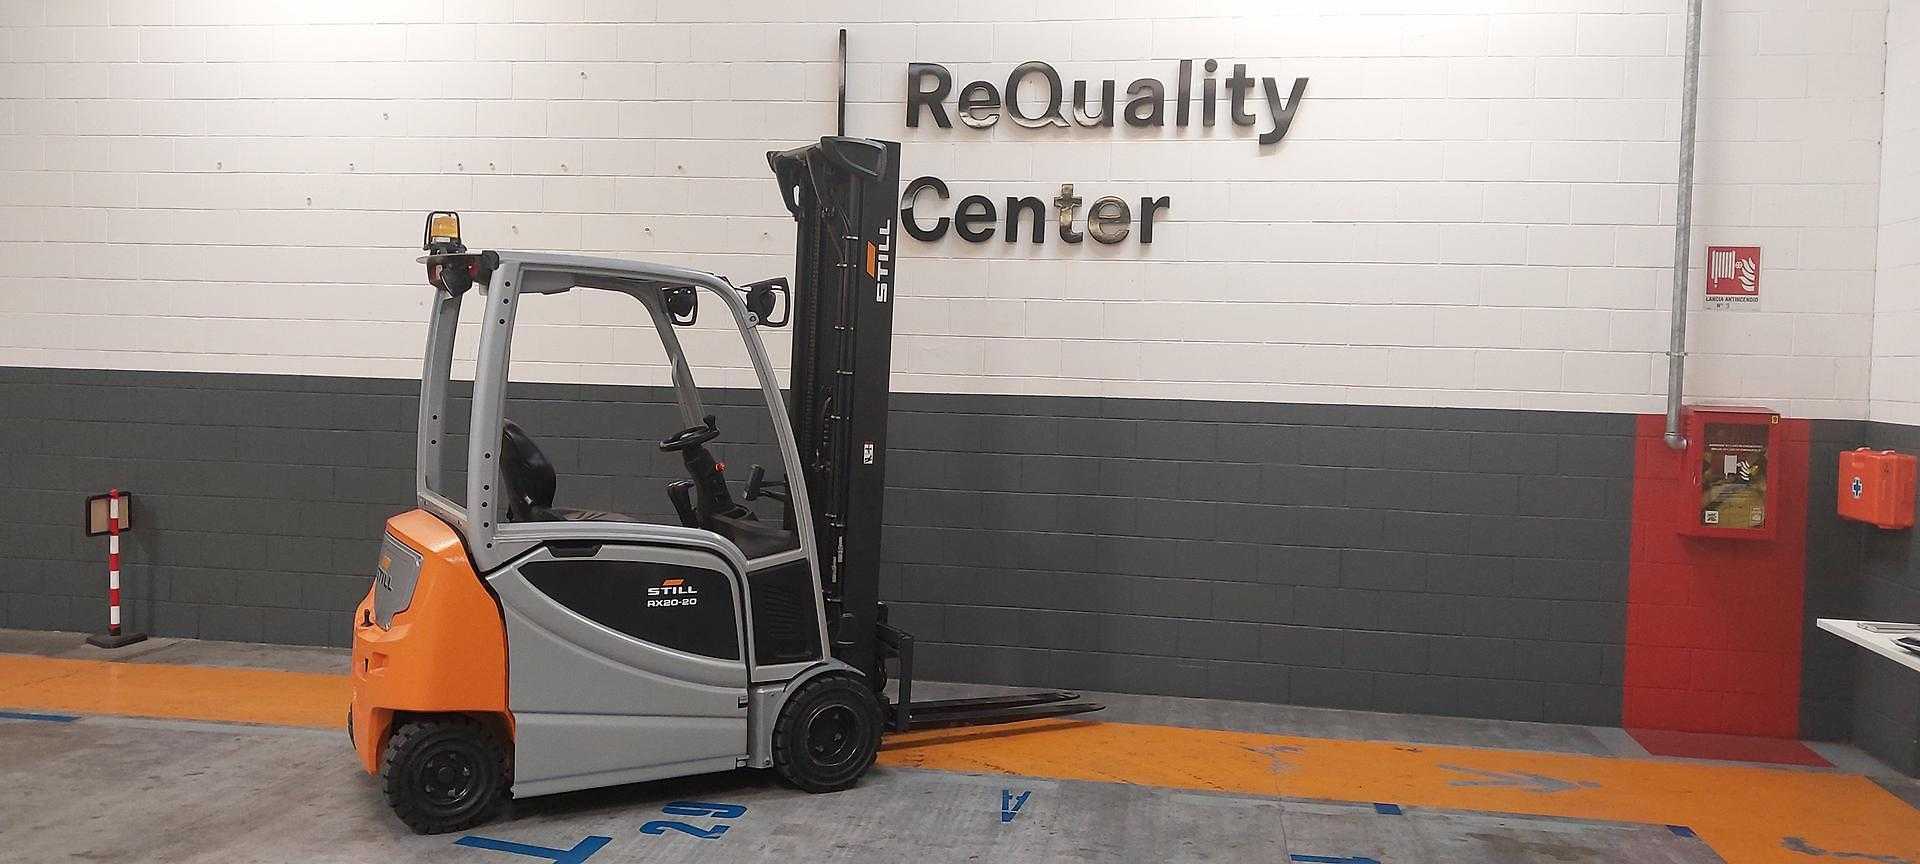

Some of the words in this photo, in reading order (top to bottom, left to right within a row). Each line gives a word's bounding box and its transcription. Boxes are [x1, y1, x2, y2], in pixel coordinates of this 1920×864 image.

[905, 59, 1309, 145] ReQuality
[900, 176, 1170, 244] Center
[876, 219, 891, 303] STILL
[647, 585, 698, 596] STILL
[647, 598, 698, 607] RX20-20
